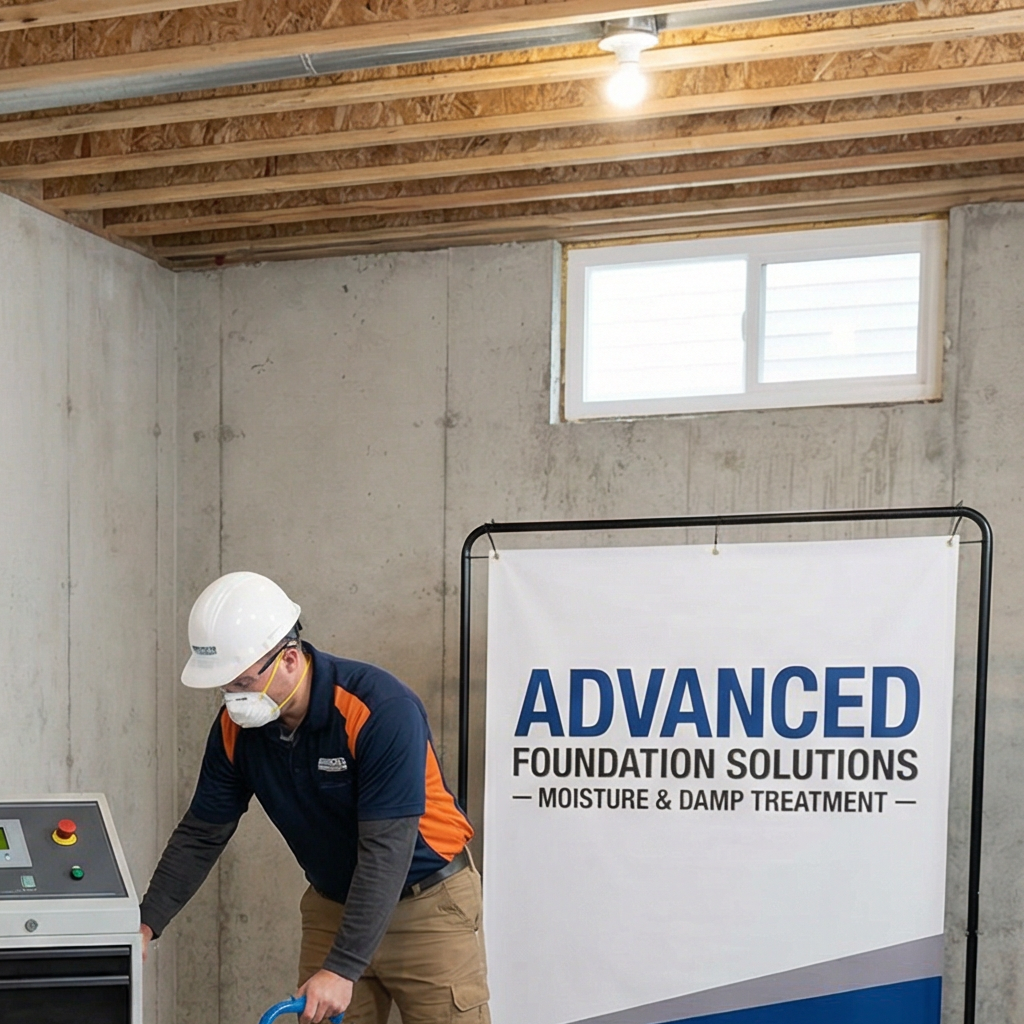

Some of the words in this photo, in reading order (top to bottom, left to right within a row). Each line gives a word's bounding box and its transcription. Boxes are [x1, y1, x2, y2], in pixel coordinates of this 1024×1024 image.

[514, 665, 921, 740] ADVANCED
[512, 746, 715, 779] FOUNDATION
[726, 748, 919, 781] SOLUTIONS
[538, 787, 649, 810] MOISTURE
[655, 788, 672, 811] &
[679, 789, 744, 811] DAMP
[751, 790, 888, 813] TREATMENT
